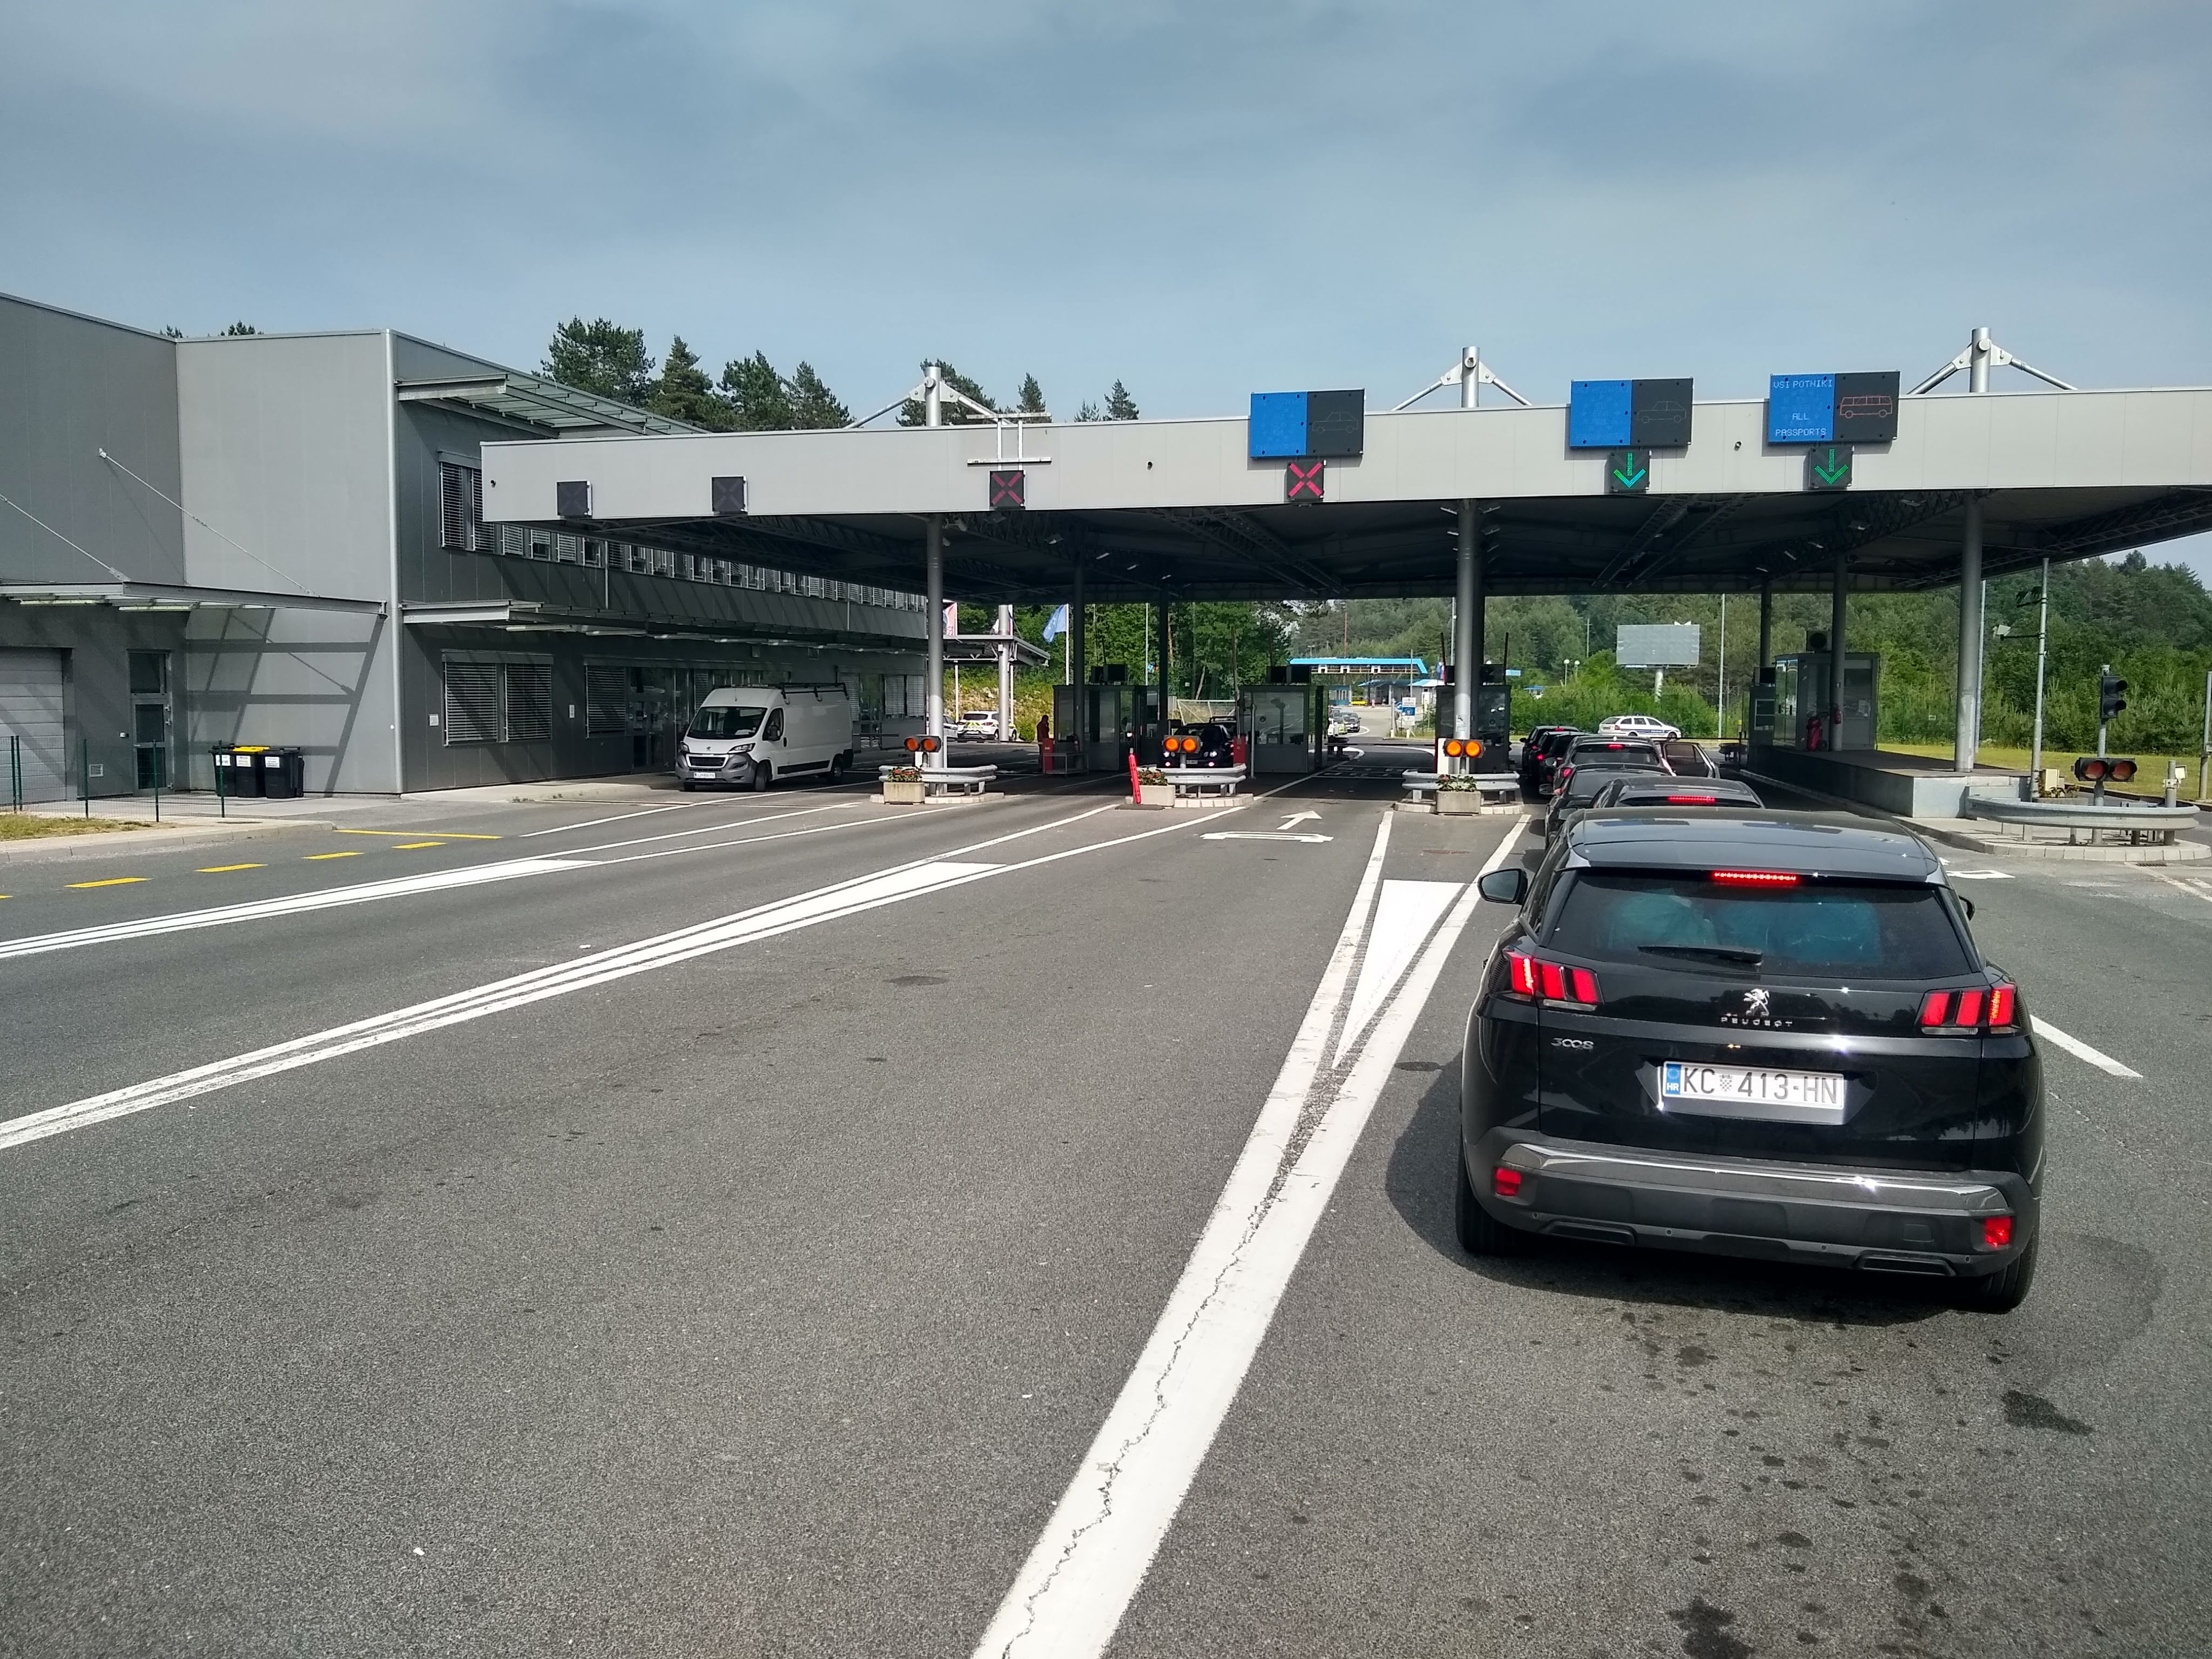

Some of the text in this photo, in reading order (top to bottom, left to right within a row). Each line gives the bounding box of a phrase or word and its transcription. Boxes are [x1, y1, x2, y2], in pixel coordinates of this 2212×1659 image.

[1773, 379, 1832, 389] VSI POTNIKI
[1775, 428, 1826, 436] PASSPORTS
[1721, 1016, 1793, 1027] PEUGEOT
[1550, 1037, 1595, 1050] 3008
[1667, 1082, 1680, 1092] HR
[1683, 1067, 1837, 1104] KC 413-HN
